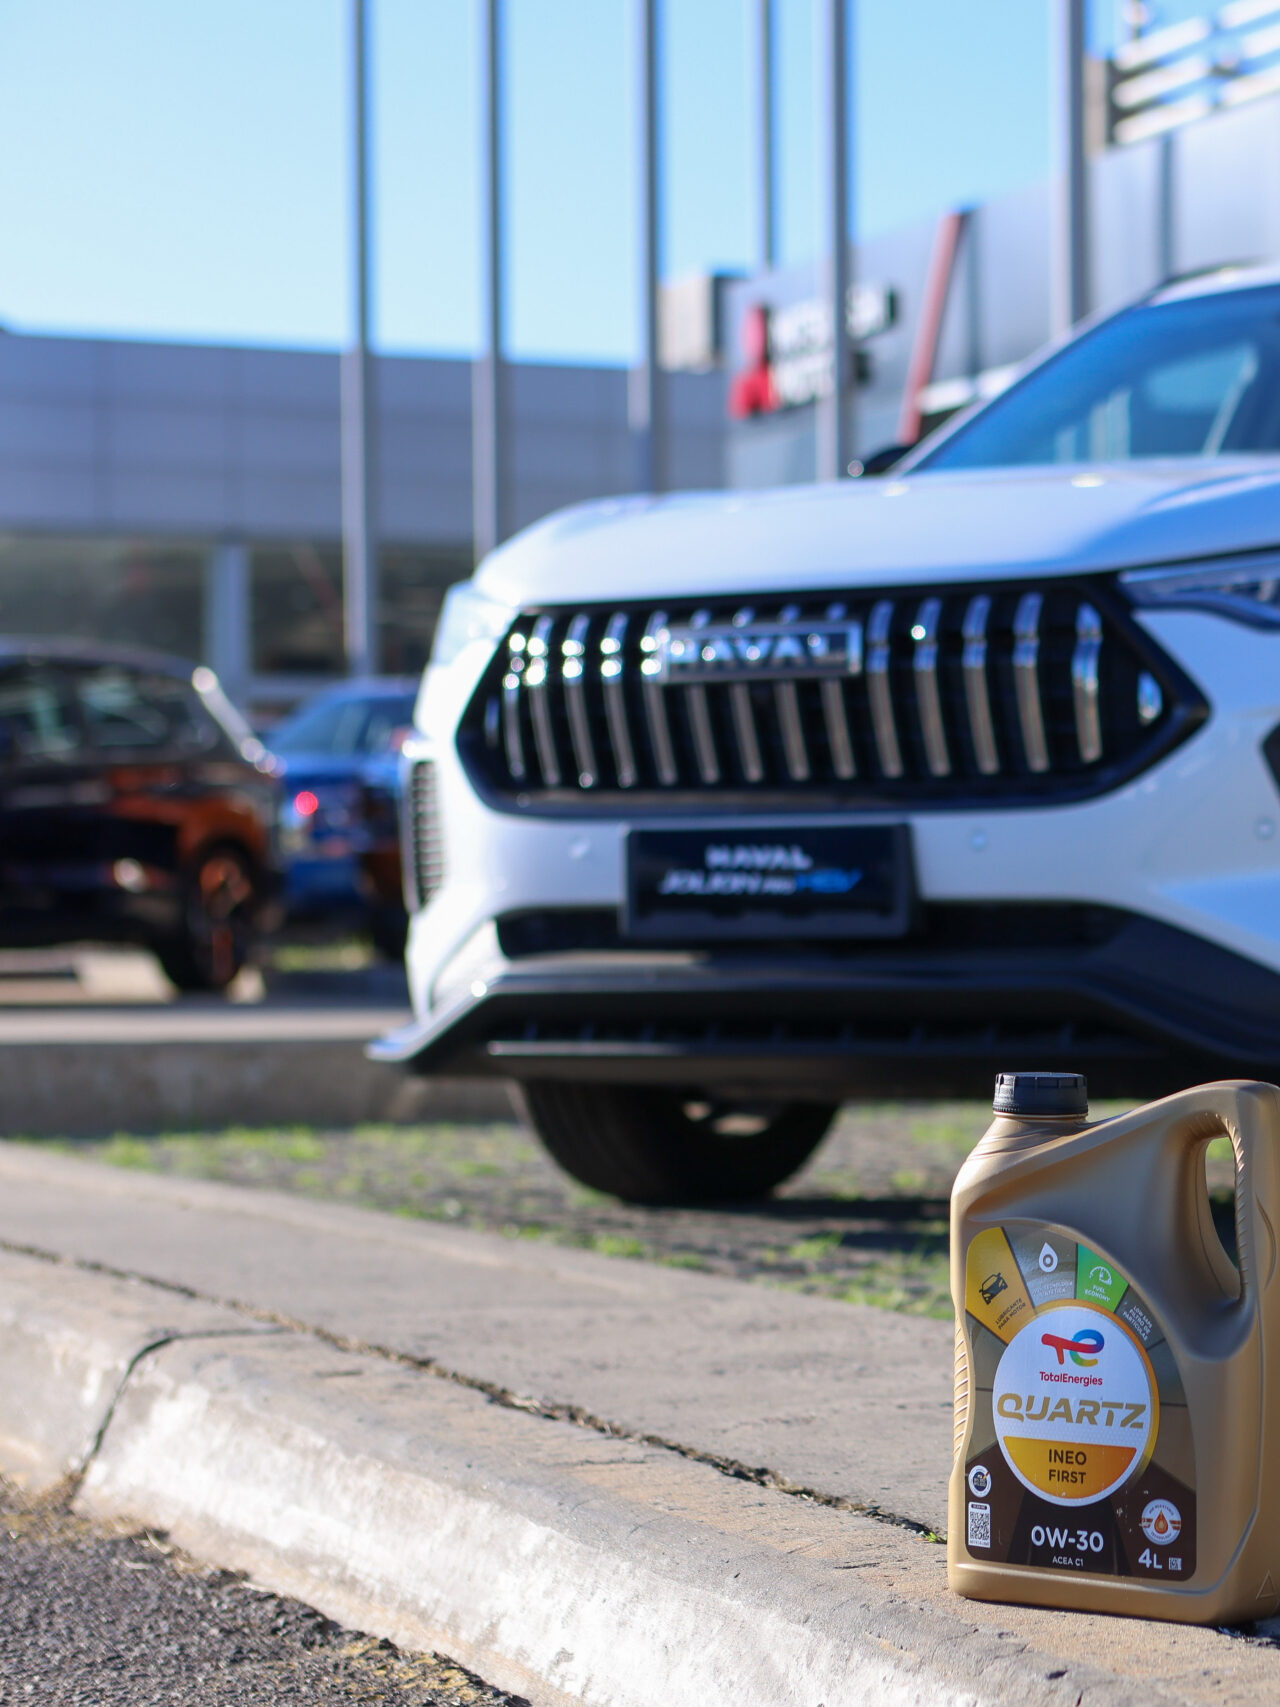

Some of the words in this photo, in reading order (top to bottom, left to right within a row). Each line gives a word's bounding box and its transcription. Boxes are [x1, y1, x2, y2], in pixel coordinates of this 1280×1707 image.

[706, 844, 813, 870] HAVAL
[1084, 1288, 1111, 1302] ECONOMY
[1093, 1284, 1106, 1294] FUEL
[1039, 1371, 1103, 1387] TotalEnergies
[997, 1392, 1147, 1430] QUARTZ
[1048, 1448, 1087, 1466] INEO
[1048, 1469, 1087, 1485] FIRST
[1031, 1525, 1104, 1553] 0W-30
[1052, 1555, 1074, 1566] ACEA
[1075, 1558, 1084, 1567] C1
[1138, 1548, 1163, 1570] 4L
